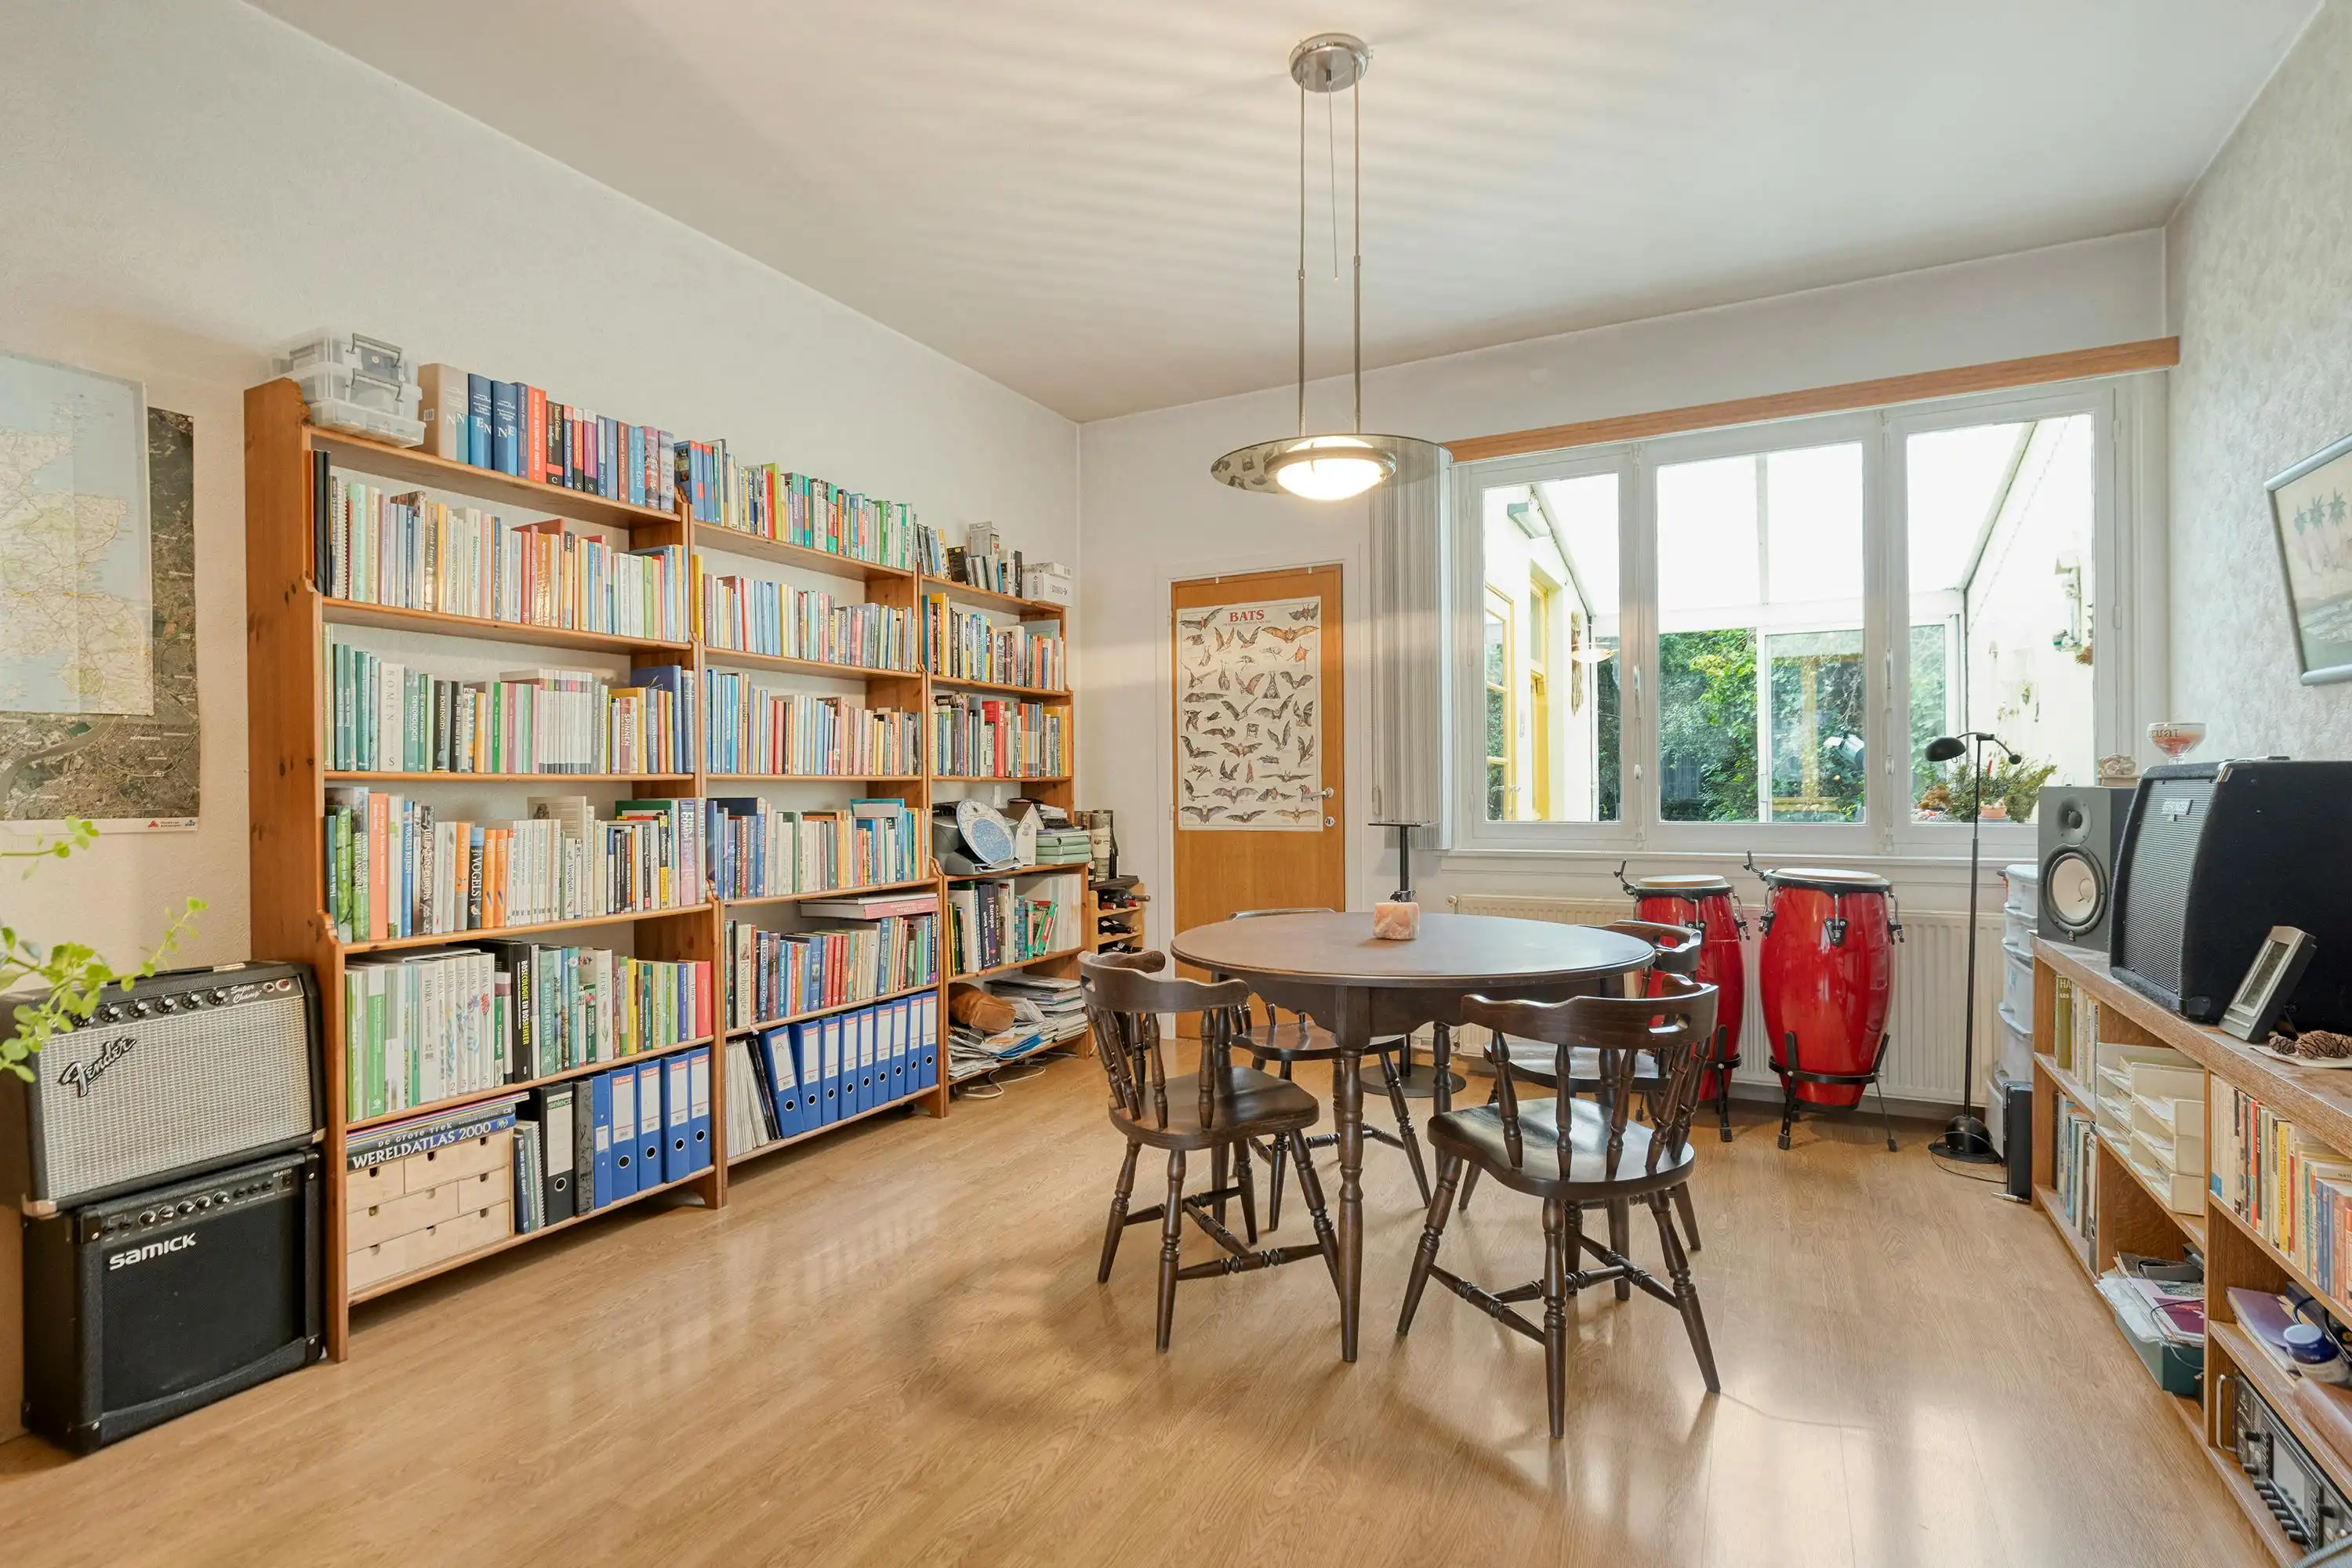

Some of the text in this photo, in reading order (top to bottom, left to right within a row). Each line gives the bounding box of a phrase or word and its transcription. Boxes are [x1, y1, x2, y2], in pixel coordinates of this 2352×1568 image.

[1229, 609, 1265, 622] BATS
[354, 855, 363, 894] LANDSCHAP
[423, 870, 433, 901] EUROPA
[470, 856, 482, 897] VOGELS
[230, 984, 256, 996] Super
[232, 990, 261, 1004] Champ
[600, 971, 608, 997] FLORA
[738, 960, 750, 1009] Psychologie
[2060, 978, 2073, 989] HA
[522, 1000, 528, 1009] EN
[56, 1036, 137, 1098] Fender
[353, 1121, 492, 1169] WERELDATLAS 2000
